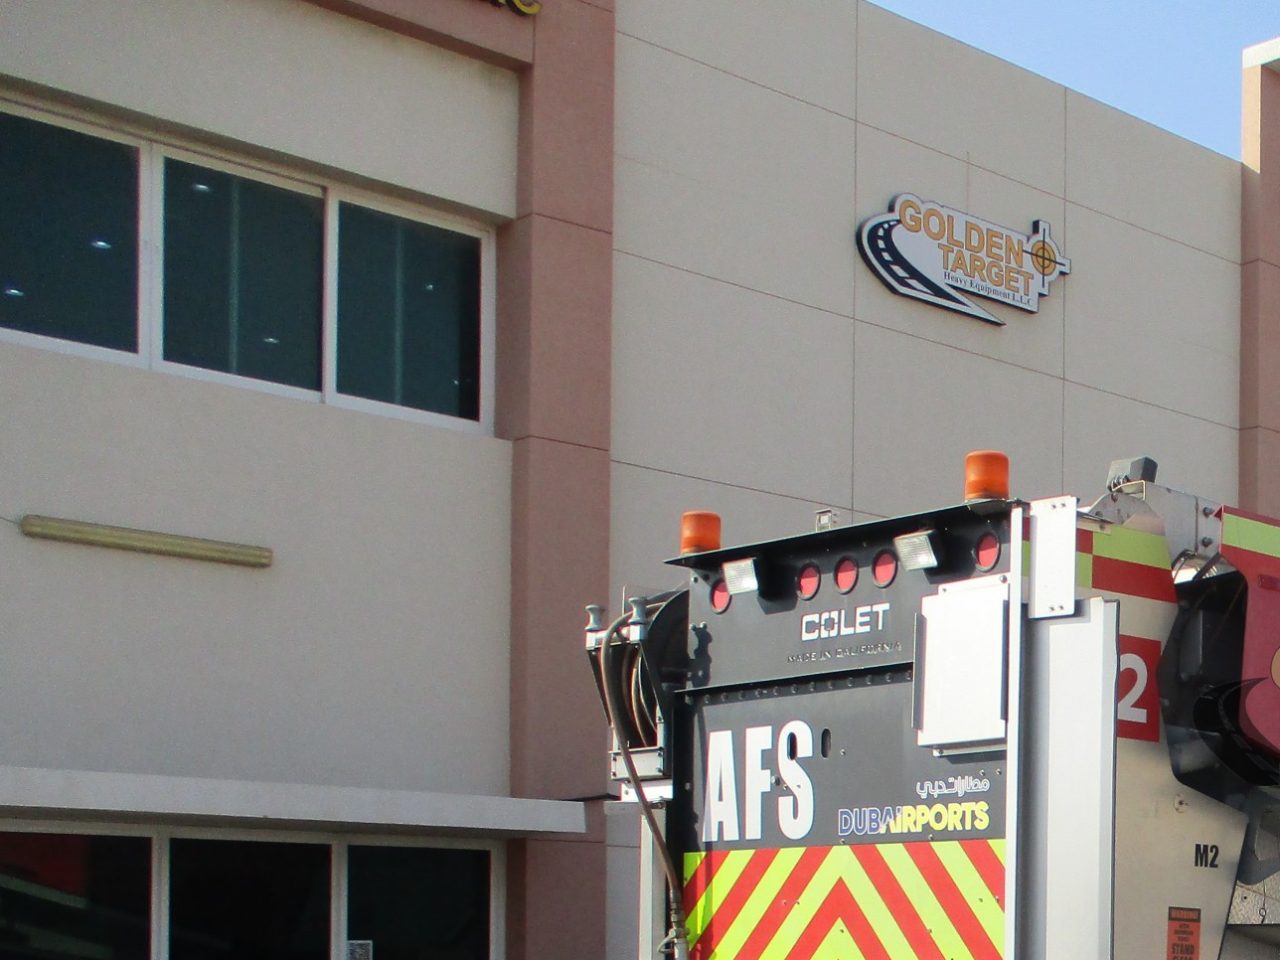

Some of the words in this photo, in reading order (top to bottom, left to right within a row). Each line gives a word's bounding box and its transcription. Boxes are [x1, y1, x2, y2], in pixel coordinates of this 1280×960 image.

[899, 199, 1024, 268] GOLDEN
[938, 242, 1034, 296] TARGET
[943, 271, 968, 286] Heavy
[970, 278, 1011, 300] Equipment
[802, 603, 890, 641] COLET
[702, 720, 813, 842] AFS
[1194, 844, 1220, 868] M2
